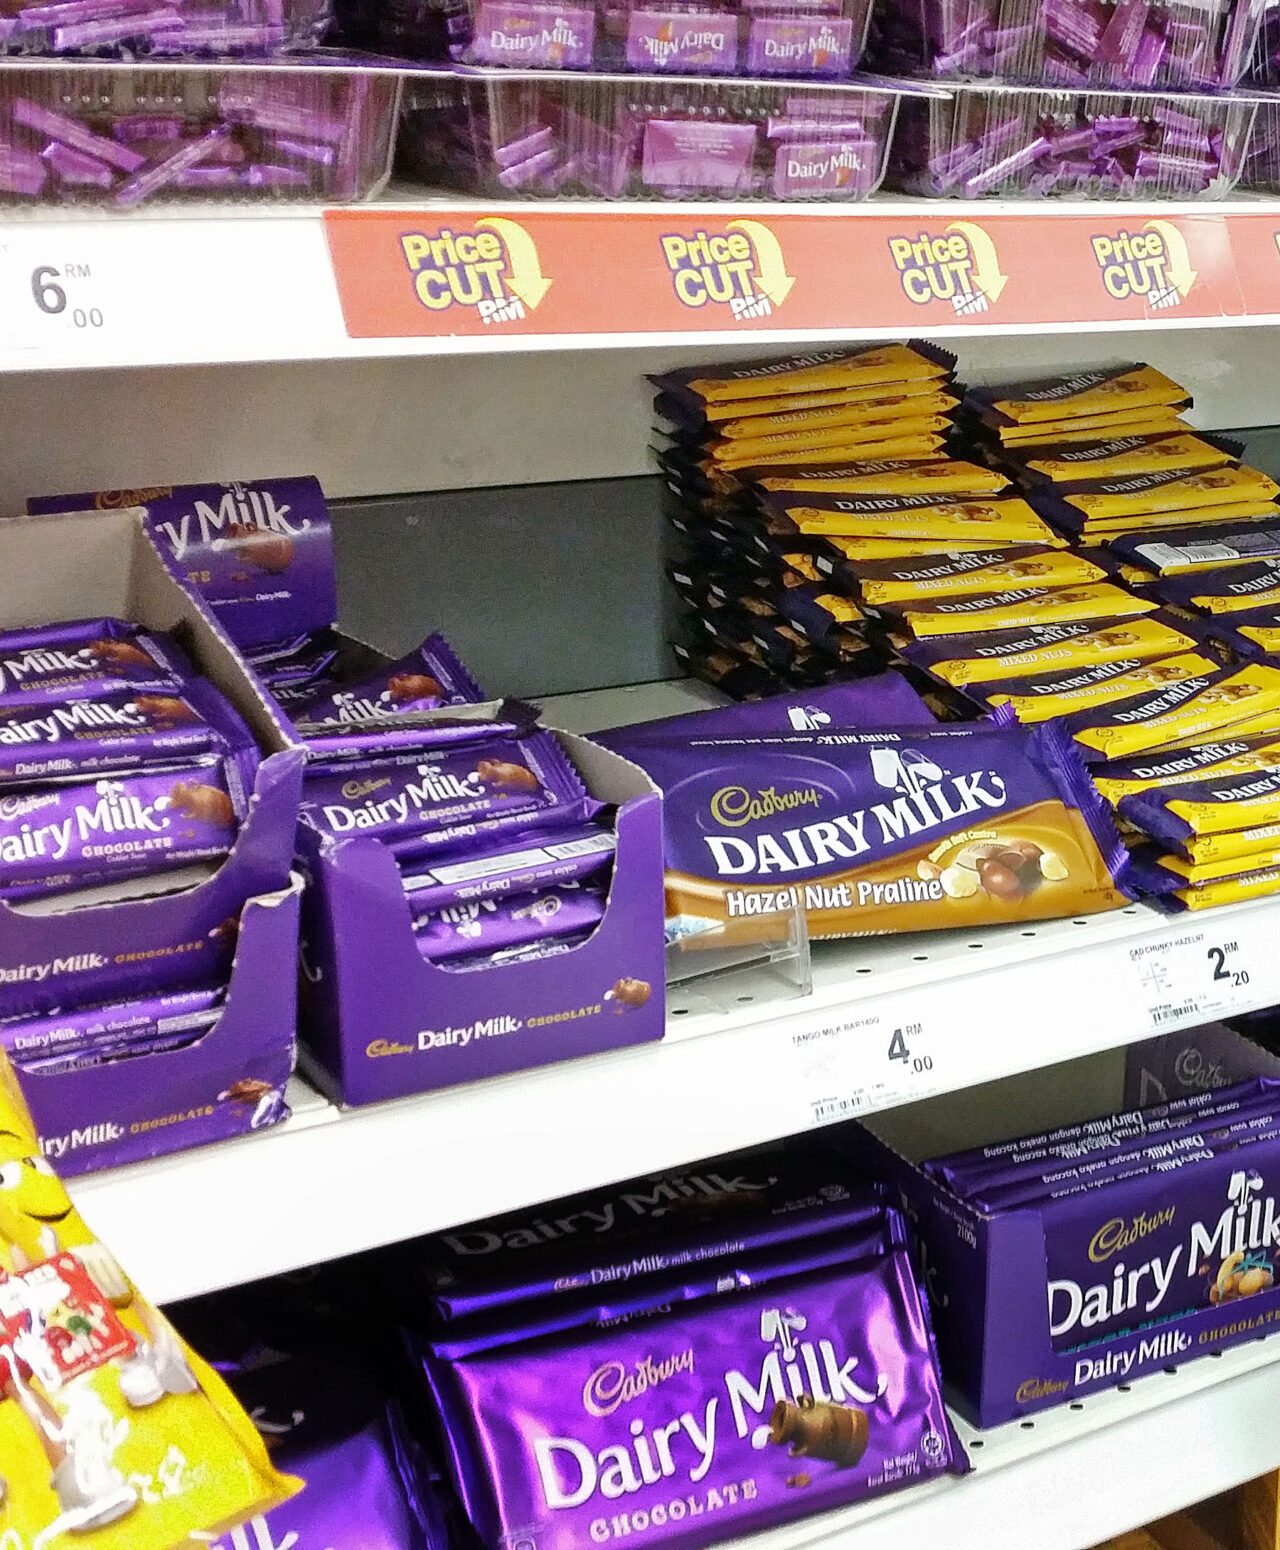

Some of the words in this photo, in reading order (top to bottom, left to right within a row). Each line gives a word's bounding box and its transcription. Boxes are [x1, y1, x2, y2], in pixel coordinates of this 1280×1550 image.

[490, 31, 539, 51] Dairy
[680, 32, 724, 50] Dairy
[765, 38, 804, 59] Dairy
[788, 160, 829, 180] Dairy
[401, 231, 500, 269] Price
[661, 232, 751, 269] Price
[890, 232, 968, 270] Price
[1093, 231, 1161, 267] Price
[31, 265, 67, 314] 6
[65, 264, 91, 278] RM
[415, 262, 504, 309] CUT
[675, 262, 754, 307] CUT
[902, 262, 971, 304] CUT
[1103, 260, 1165, 298] CUT
[734, 364, 793, 378] DAIRY
[1026, 387, 1069, 401] DAIRY
[1069, 373, 1105, 393] MILK
[1061, 446, 1107, 461] DAIRY
[1107, 436, 1145, 454] MILK
[1102, 475, 1149, 493] DAIRY
[1149, 469, 1191, 484] MILK
[835, 497, 901, 511] DAIRY
[904, 495, 956, 506] MILK
[194, 490, 311, 552] Milk
[893, 565, 953, 580] DAIRY
[955, 553, 1004, 572] MILK
[937, 597, 997, 612] DAIRY
[997, 587, 1049, 605] MILK
[1228, 577, 1277, 593] DAIRY
[976, 640, 1037, 657] DAIRY
[1037, 624, 1090, 648] MILK
[998, 653, 1038, 666] MIXED
[1041, 648, 1073, 661] NUTS
[4, 649, 100, 680] Milk
[1031, 673, 1091, 693] DAIRY
[1090, 659, 1141, 682] MILK
[53, 701, 146, 731] Milk
[1113, 701, 1167, 723] DAIRY
[1164, 678, 1209, 707] MILK
[1144, 714, 1180, 729] MIXED
[15, 761, 47, 775] Dairy
[48, 758, 73, 771] Milk
[1132, 760, 1199, 779] DAIRY
[1199, 742, 1249, 765] MILK
[322, 792, 410, 833] Dairy
[405, 773, 486, 809] Milk
[711, 785, 819, 828] Cadbury
[1212, 781, 1274, 802] DAIRY
[75, 795, 170, 841] Milk
[420, 798, 492, 821] CHOCOLATE
[704, 819, 877, 875] DAIRY
[881, 771, 1006, 840] MILK
[82, 836, 173, 857] CHOCOLATE
[1238, 871, 1280, 886] MIXED
[727, 887, 798, 917] Hazel
[803, 881, 852, 910] Nut
[858, 877, 943, 910] Praline
[52, 953, 104, 975] Milk
[114, 941, 204, 964] CHOCOLATE
[1130, 947, 1144, 957] CAD
[1145, 941, 1173, 953] CHUNKY
[1175, 934, 1204, 946] HAZELNT
[1208, 947, 1230, 981] 2
[1224, 942, 1239, 954] RM
[15, 1035, 48, 1050] Dairy
[49, 1026, 79, 1043] Milk
[418, 1026, 473, 1051] Dairy
[474, 1015, 519, 1040] Milk
[527, 1004, 602, 1029] CHOCOLATE
[792, 1031, 820, 1044] TANGO
[823, 1026, 841, 1037] MILK
[888, 1029, 910, 1064] 4
[906, 1023, 923, 1036] RM
[71, 1122, 120, 1149] Milk
[130, 1105, 214, 1134] CHOCOLATE
[1112, 1111, 1143, 1132] Dairy
[983, 1141, 1018, 1158] kacang
[1174, 1134, 1205, 1154] Dairy
[1042, 1167, 1077, 1184] kacang
[443, 1202, 616, 1256] Dairy
[620, 1171, 768, 1217] Milk
[1088, 1204, 1176, 1262] Cadbury
[590, 1264, 632, 1285] Dairy
[632, 1255, 665, 1276] Milk
[671, 1251, 692, 1267] milk
[695, 1241, 745, 1262] chocolate
[1048, 1243, 1184, 1336] Dairy
[1074, 1345, 1136, 1386] Dairy
[1137, 1329, 1188, 1364] Milk
[582, 1347, 694, 1418] Cadbury
[534, 1397, 718, 1510] Dairy
[725, 1340, 886, 1439] Milk
[590, 1478, 758, 1544] CHOCOLATE
